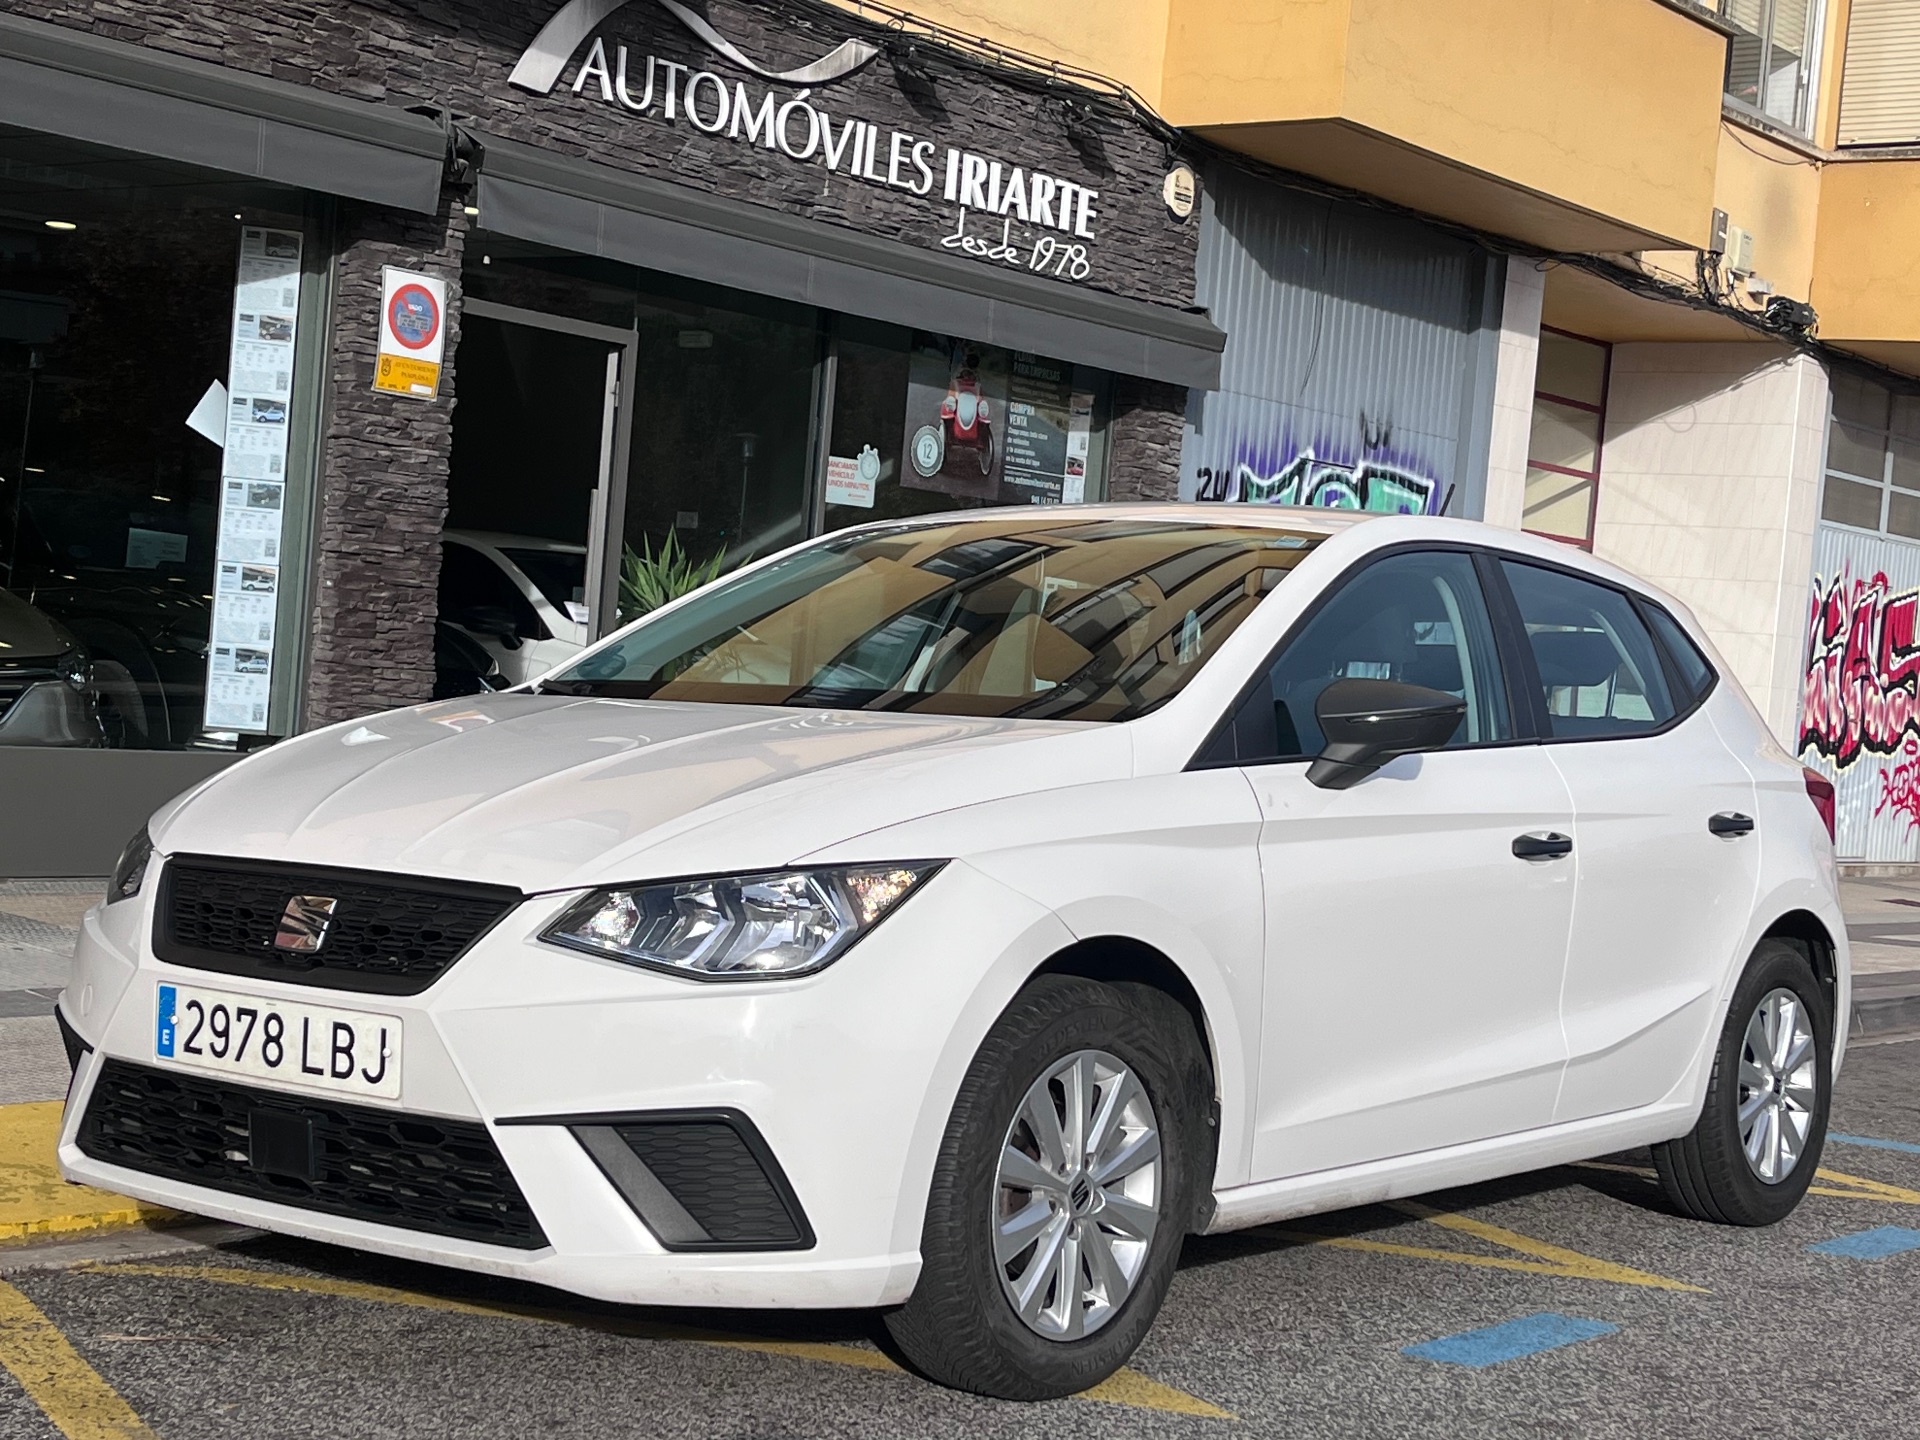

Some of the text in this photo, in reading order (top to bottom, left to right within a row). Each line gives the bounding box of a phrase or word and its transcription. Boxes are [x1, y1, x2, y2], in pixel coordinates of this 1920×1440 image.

[571, 37, 1098, 239] AUTOMÓVILES IRIARTE
[941, 207, 1090, 279] desde 1978
[1010, 402, 1035, 416] COMPRA
[1009, 413, 1028, 427] VENTA
[923, 443, 933, 459] 12
[828, 460, 858, 471] ANCIAMOS
[162, 1029, 170, 1045] E
[183, 999, 388, 1084] 2978 LBJ
